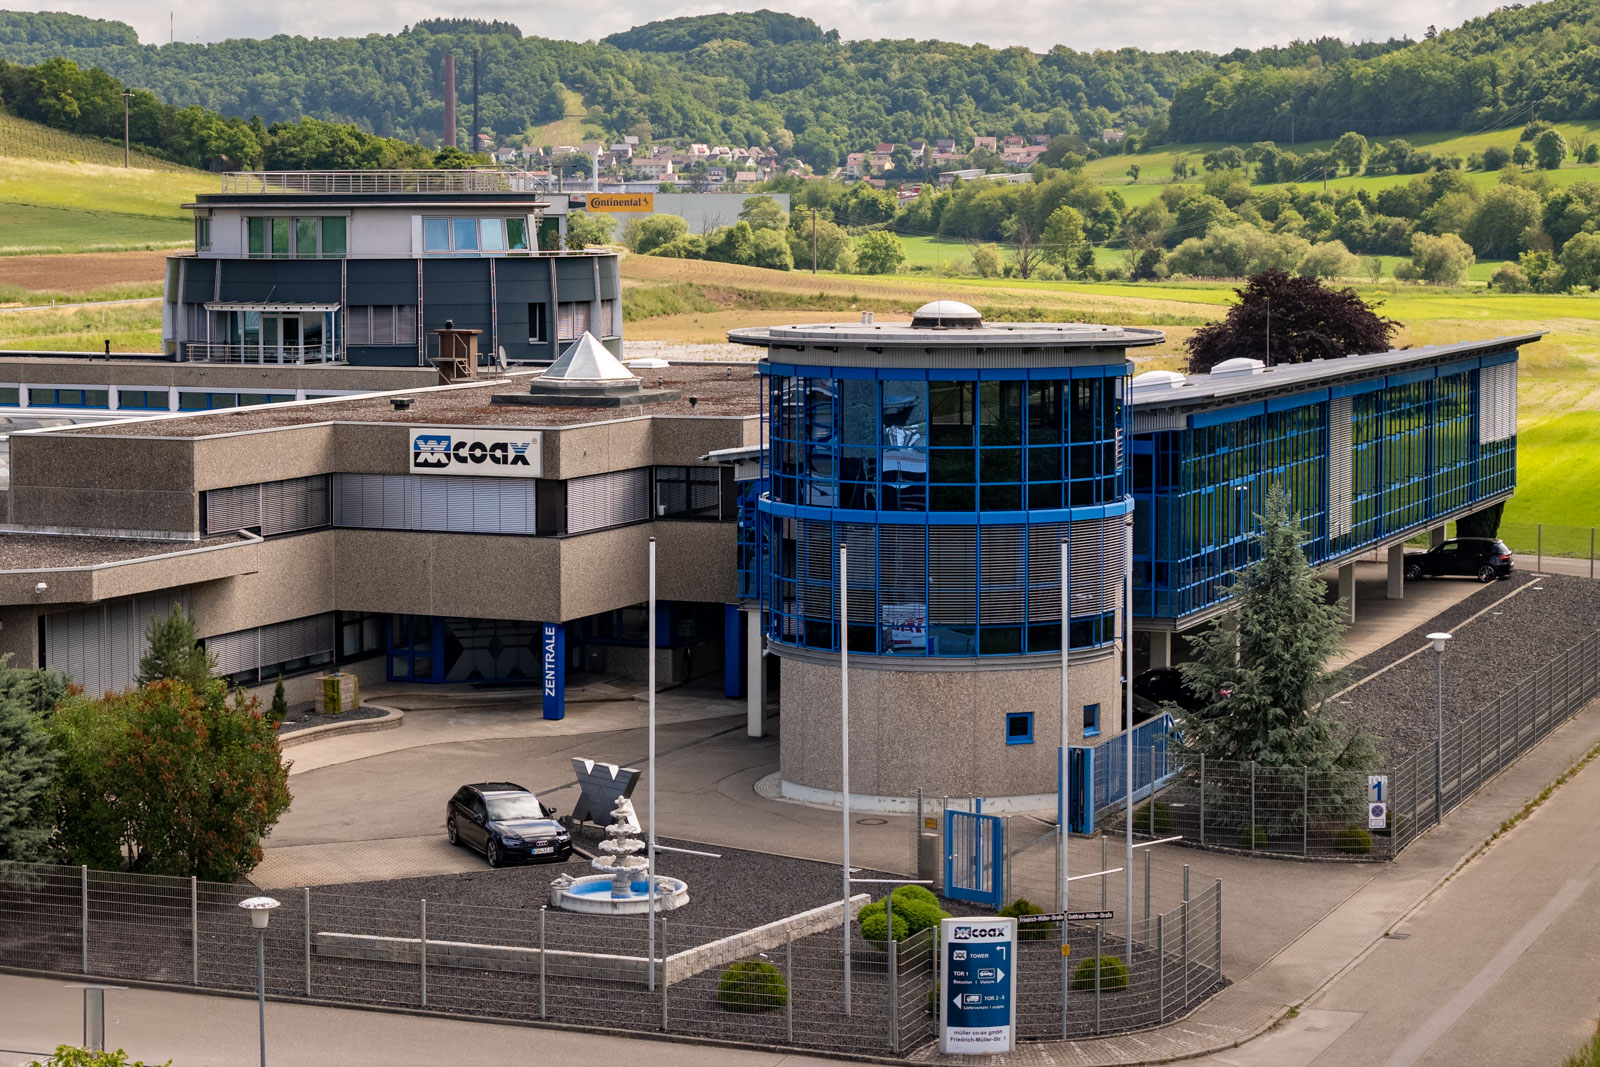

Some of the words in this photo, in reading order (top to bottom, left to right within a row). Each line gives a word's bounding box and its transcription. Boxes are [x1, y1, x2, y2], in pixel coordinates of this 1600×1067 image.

[590, 197, 642, 209] Continental
[545, 626, 556, 697] ZENTRALE
[1368, 775, 1388, 785] TOR
[1372, 780, 1382, 802] 1
